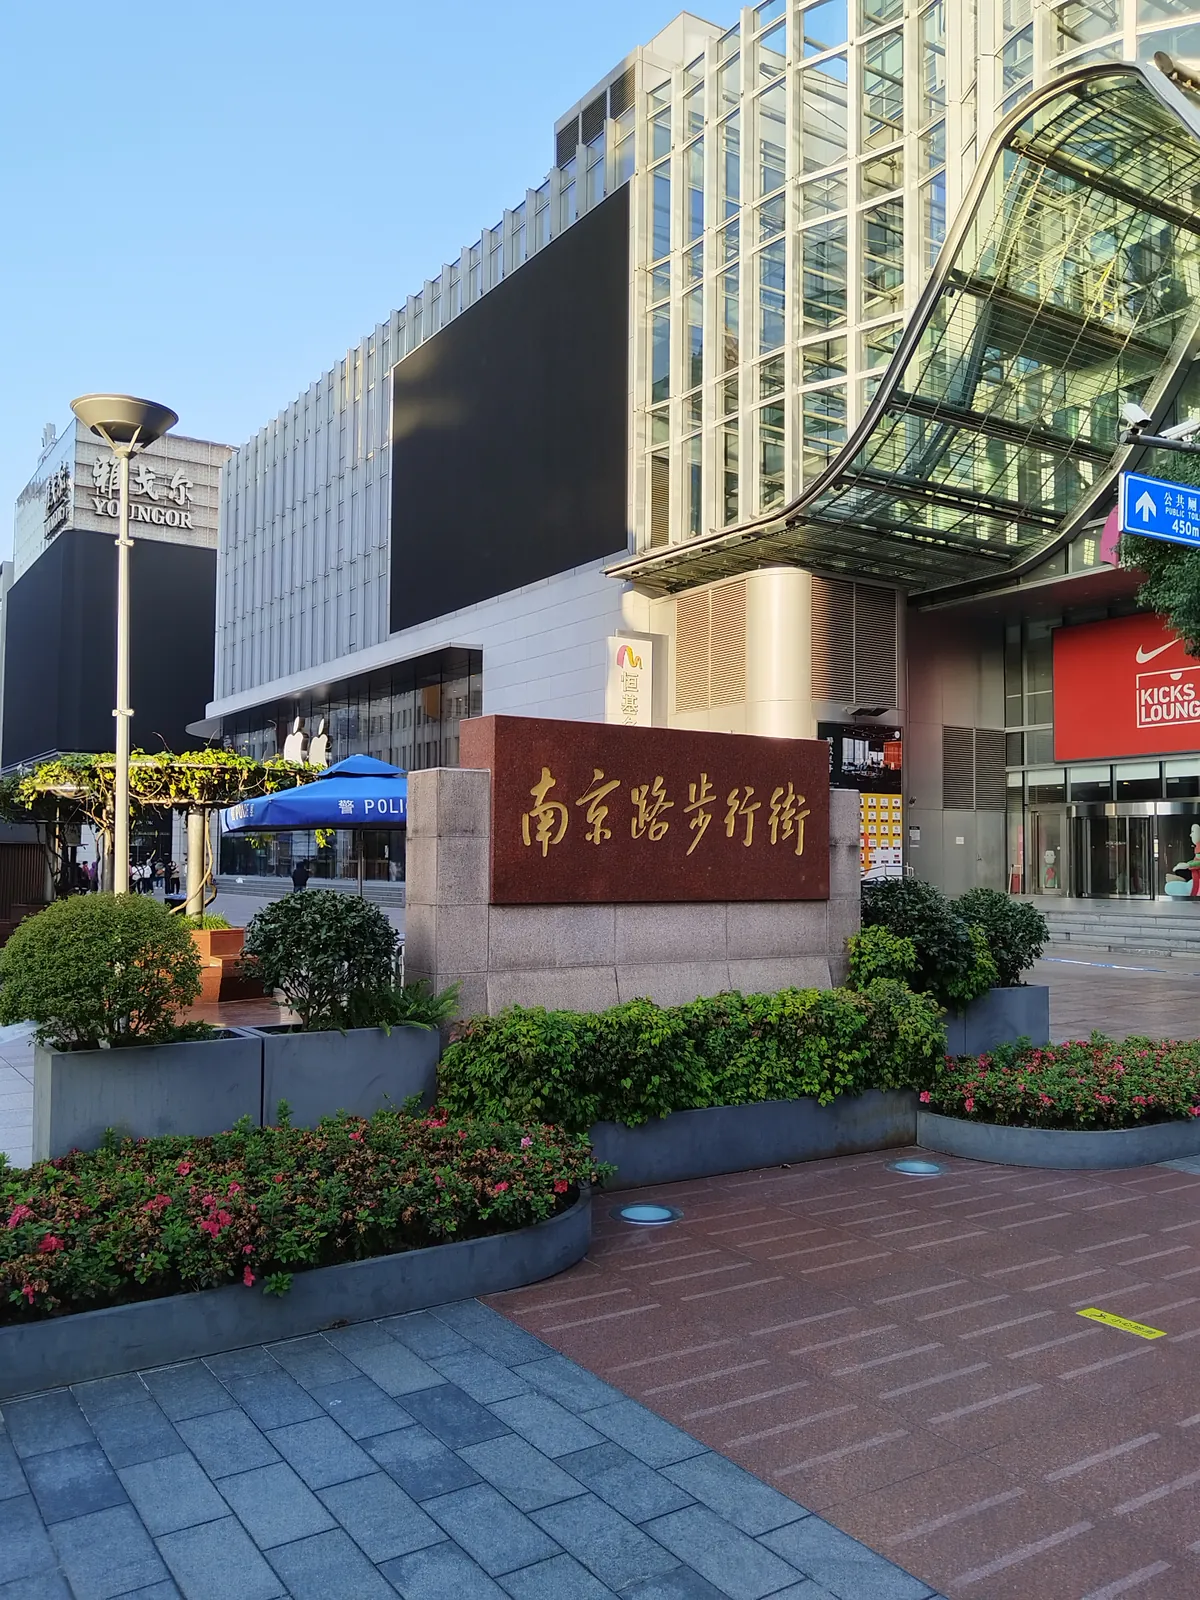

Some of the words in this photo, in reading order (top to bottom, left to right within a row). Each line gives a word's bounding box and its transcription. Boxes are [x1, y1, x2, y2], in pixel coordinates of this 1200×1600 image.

[93, 455, 194, 506] 雅戈尔
[1165, 507, 1185, 518] PUBLIC
[1171, 518, 1199, 537] 450m
[1140, 683, 1196, 706] KICKS
[1141, 700, 1200, 722] LOUNG
[338, 800, 354, 814] 警
[364, 798, 407, 814] POLI
[521, 766, 811, 857] 南京路步行街
